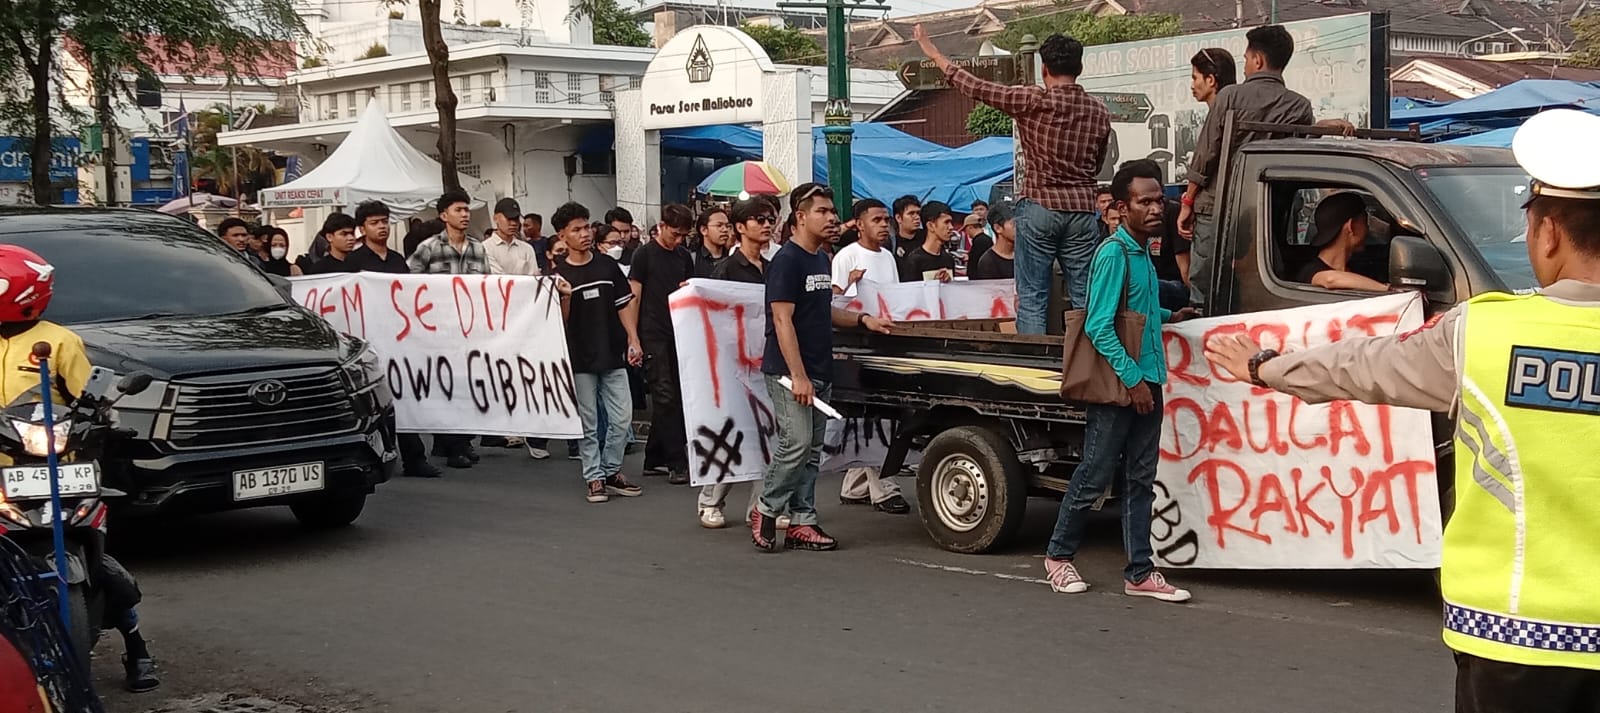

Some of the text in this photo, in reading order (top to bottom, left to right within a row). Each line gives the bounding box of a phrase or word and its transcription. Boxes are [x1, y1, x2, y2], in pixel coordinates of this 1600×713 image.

[1083, 50, 1121, 76] SAR
[1127, 43, 1175, 73] SORE
[650, 103, 675, 115] Pasar
[678, 100, 700, 113] Sore
[390, 280, 437, 341] SE
[388, 350, 579, 418] OWO GIBRAN
[8, 466, 91, 482] AB 450 KP
[240, 465, 319, 490] AB 1370 VS
[1187, 457, 1435, 559] RAKYAT
